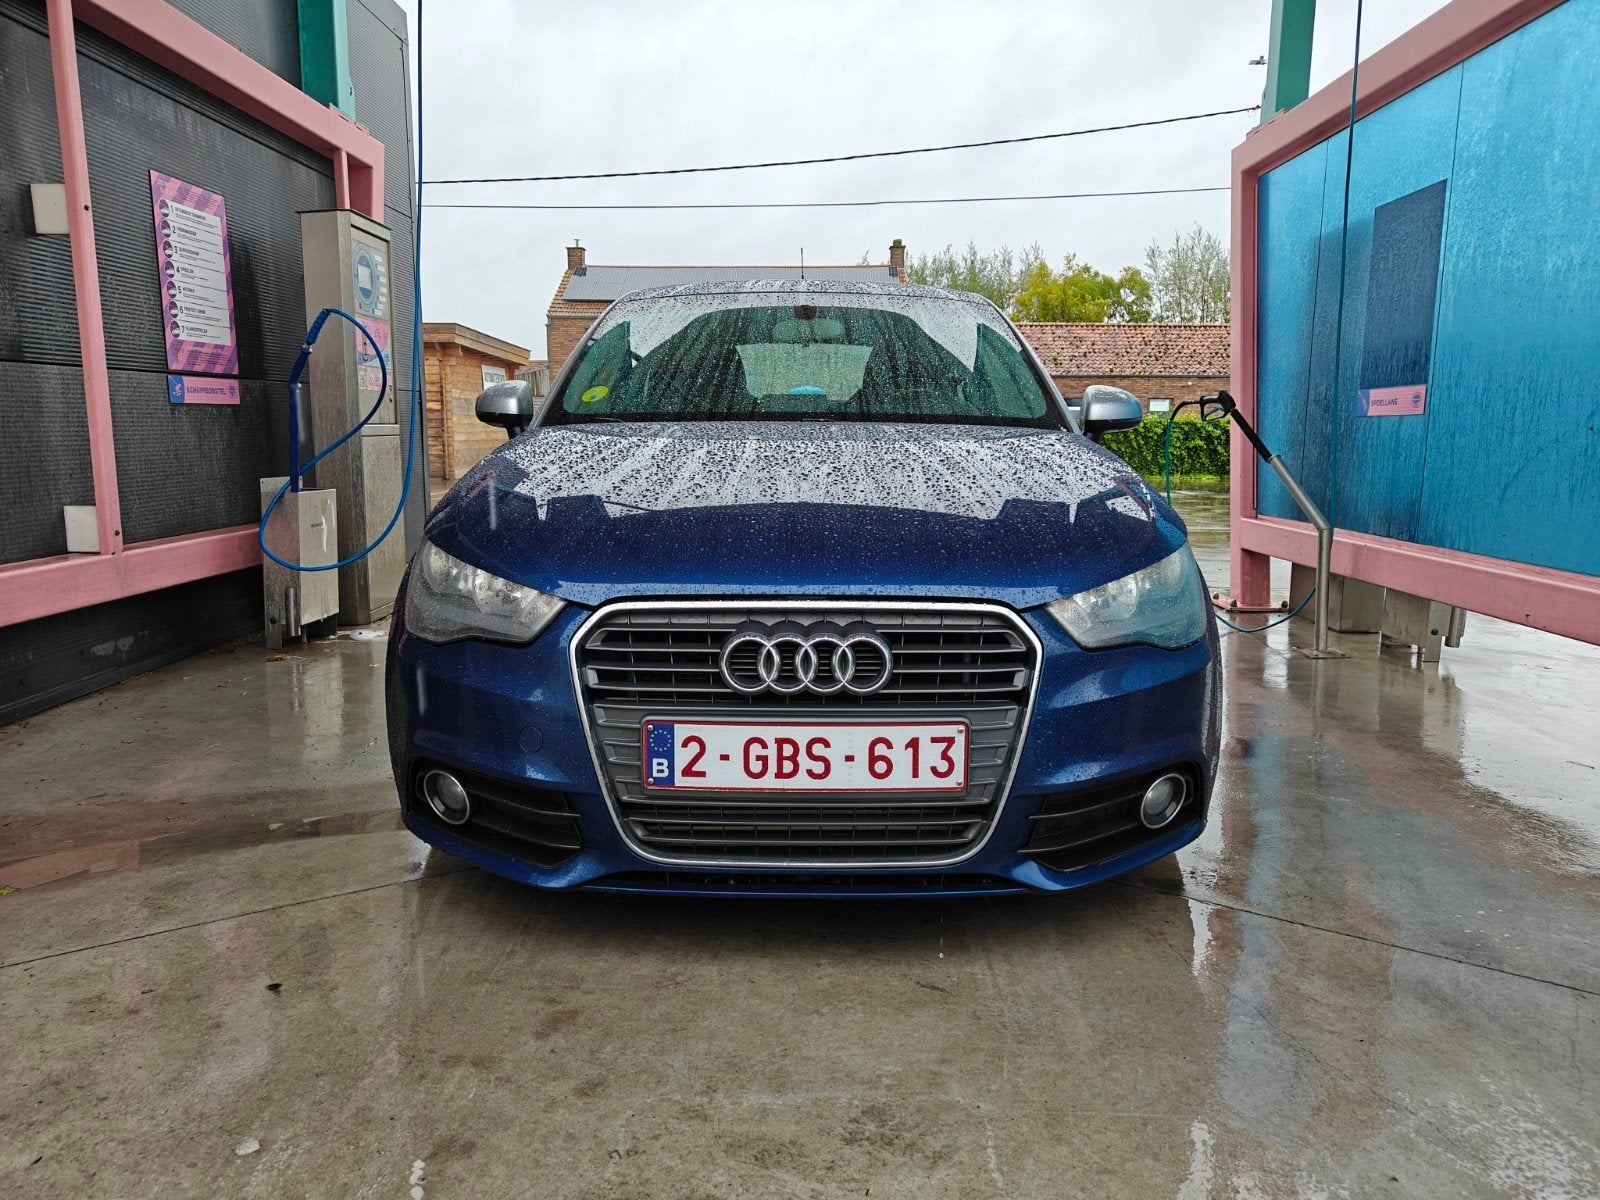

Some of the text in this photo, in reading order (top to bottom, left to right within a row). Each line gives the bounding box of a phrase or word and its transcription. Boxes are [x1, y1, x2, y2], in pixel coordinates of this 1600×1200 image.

[187, 386, 227, 396] SCHUIMBORSTEL
[1371, 398, 1398, 407] SPOELLANS
[652, 758, 669, 778] B
